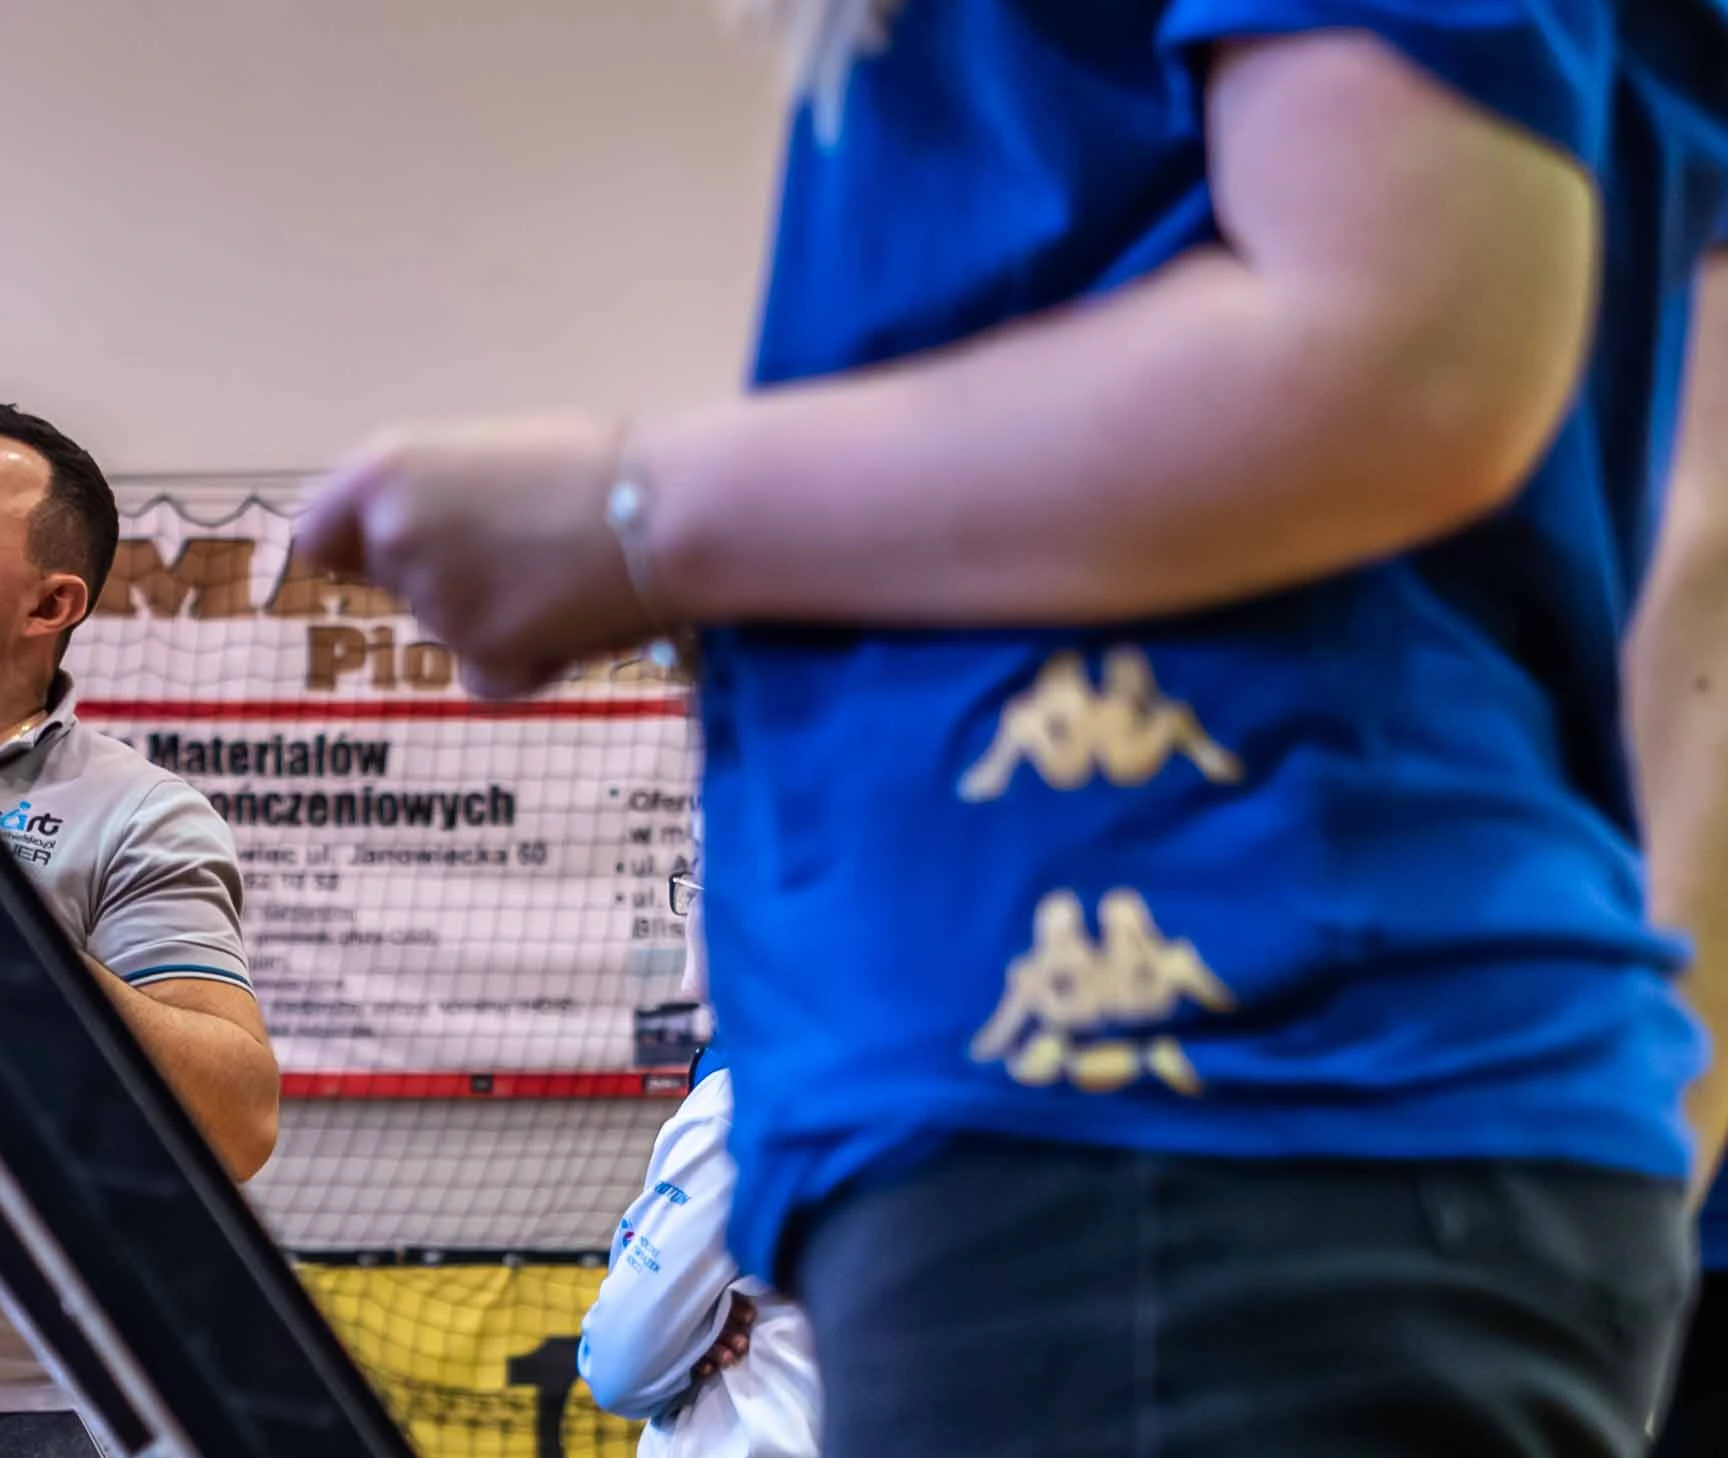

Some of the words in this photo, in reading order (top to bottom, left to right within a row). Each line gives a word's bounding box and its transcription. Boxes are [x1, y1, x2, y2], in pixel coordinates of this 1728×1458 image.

[307, 625, 457, 690] Pio
[147, 732, 391, 776] Materiałów
[211, 782, 516, 830] ończeniowych
